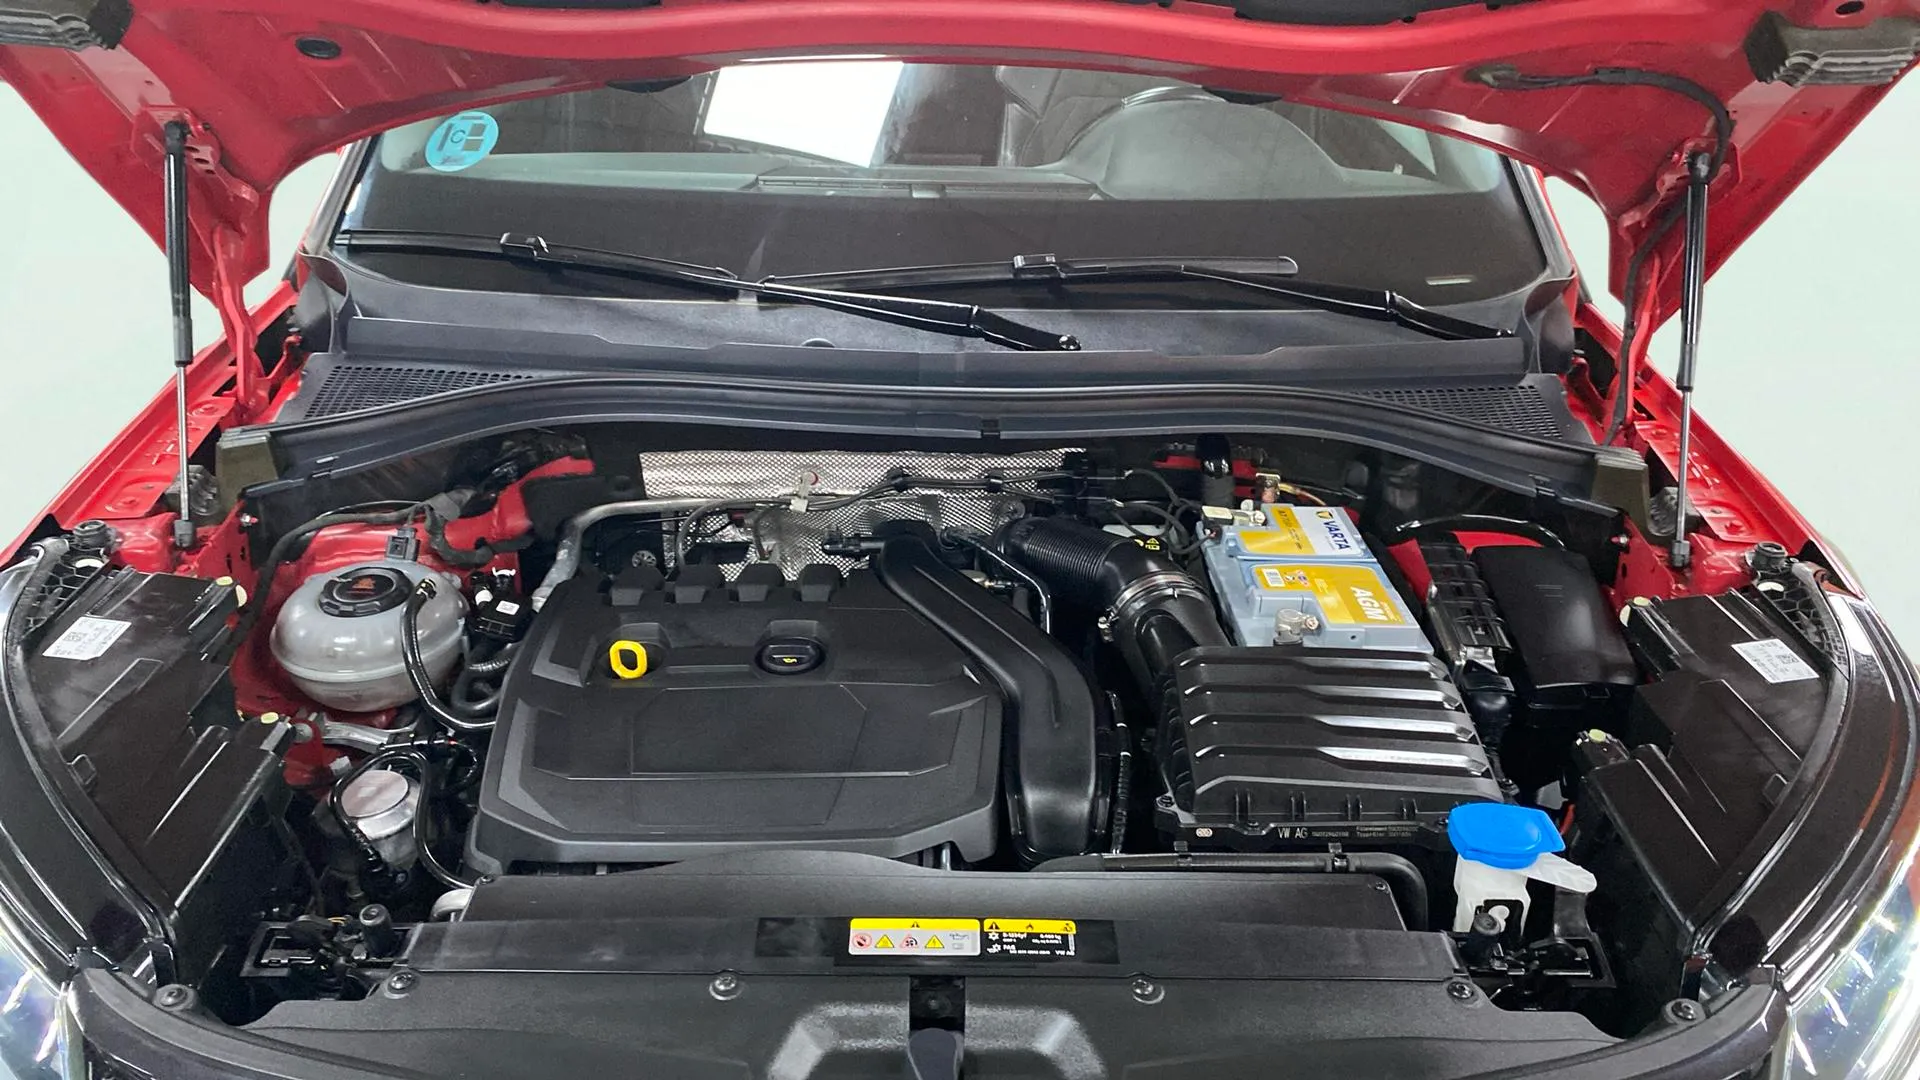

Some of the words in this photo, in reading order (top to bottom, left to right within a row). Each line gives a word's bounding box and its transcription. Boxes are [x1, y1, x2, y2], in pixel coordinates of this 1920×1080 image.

[1323, 520, 1351, 550] VARTA
[1350, 586, 1388, 622] AGM
[1278, 827, 1290, 839] VW
[1294, 827, 1308, 839] AG
